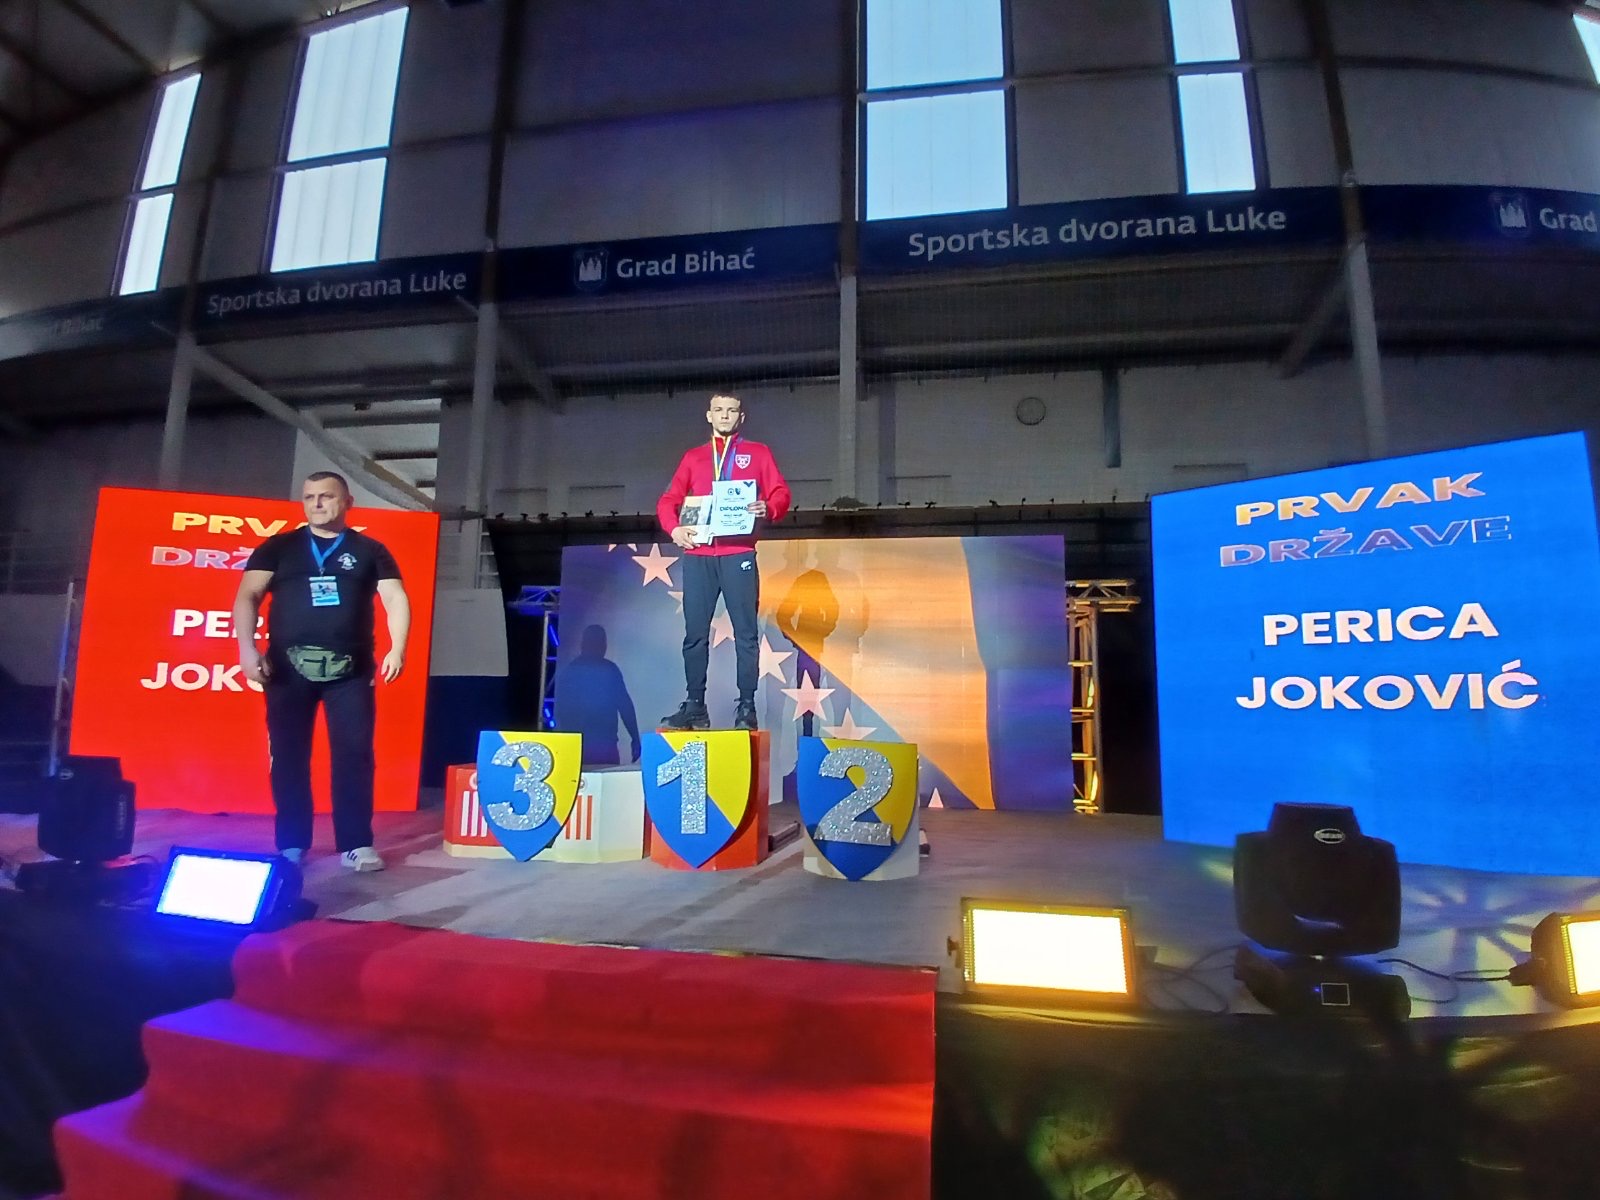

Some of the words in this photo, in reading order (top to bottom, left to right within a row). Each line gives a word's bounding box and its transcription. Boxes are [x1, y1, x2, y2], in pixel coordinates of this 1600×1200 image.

[908, 222, 1050, 261] Sportska
[1058, 213, 1197, 243] dvorana
[1206, 206, 1288, 234] Luke
[1539, 207, 1598, 233] Grad
[616, 254, 676, 279] Grad
[684, 247, 756, 273] Bihać
[206, 286, 301, 319] Sportska
[306, 278, 402, 303] dvorana
[409, 270, 467, 293] Luke
[1235, 472, 1486, 526] PRVAK
[151, 546, 256, 571] DRŽ
[1219, 515, 1512, 568] DRŽAVE
[1263, 602, 1500, 647] PERICA
[1235, 659, 1540, 711] JOKOVIĆ
[486, 741, 555, 831] 3
[656, 740, 708, 835] 1
[813, 746, 895, 847] 2
